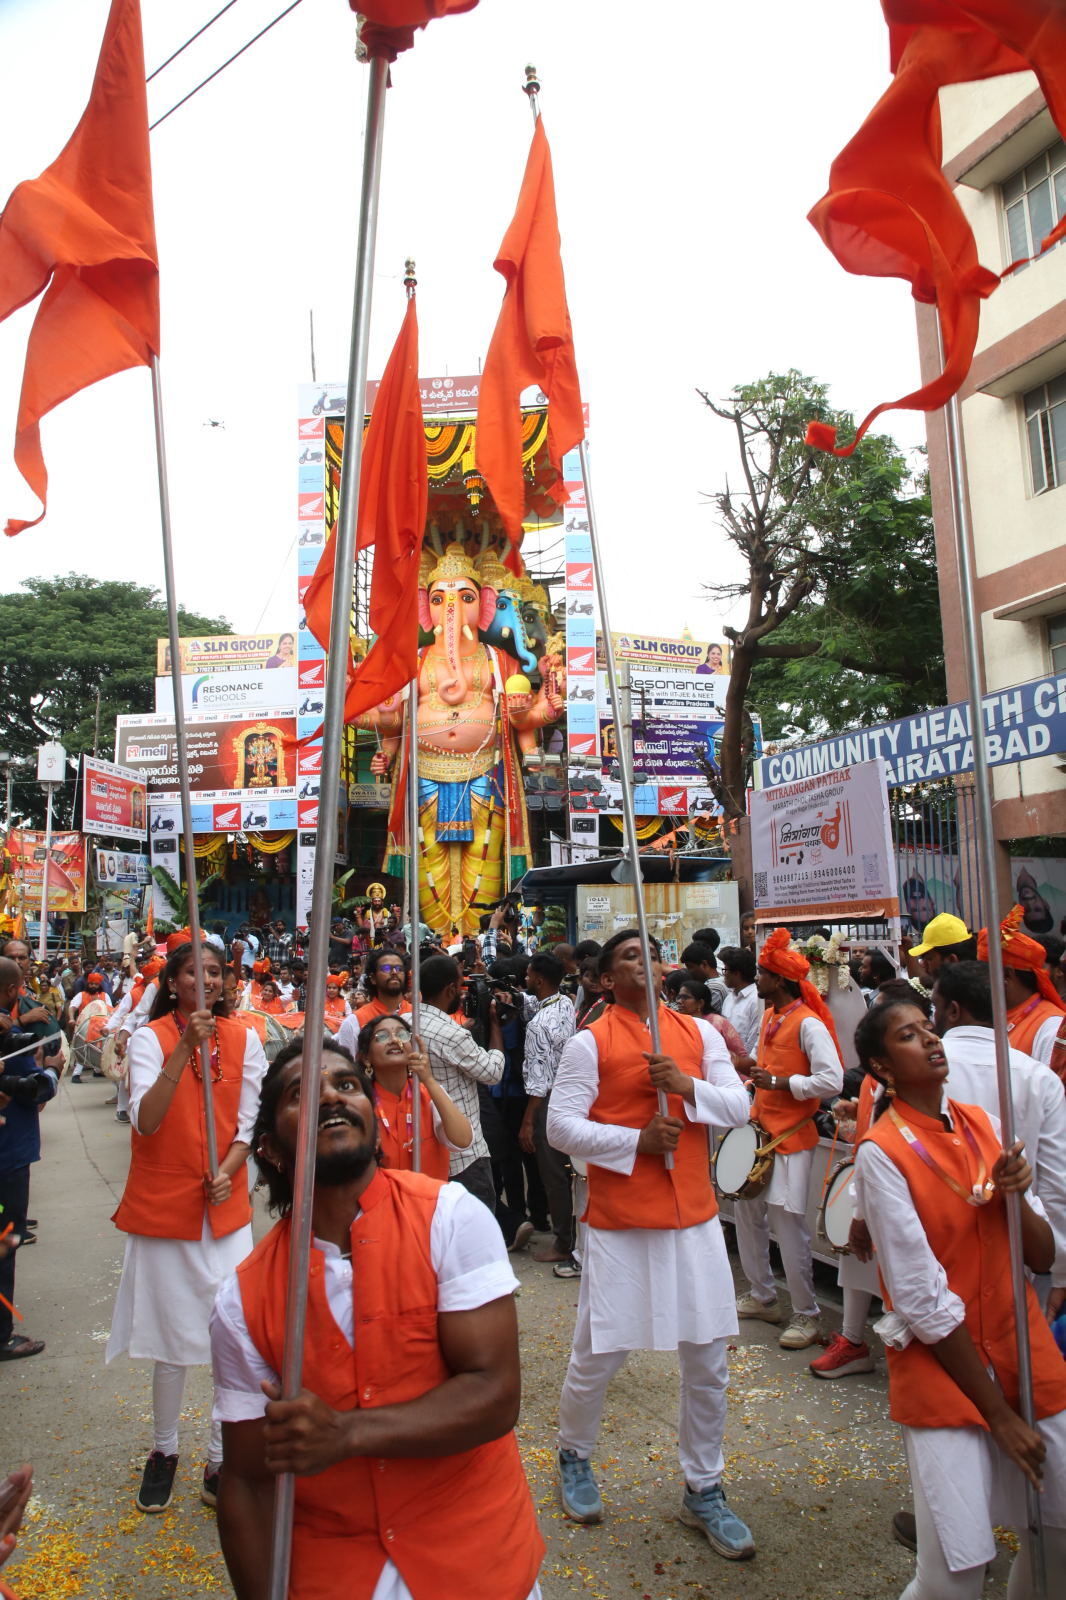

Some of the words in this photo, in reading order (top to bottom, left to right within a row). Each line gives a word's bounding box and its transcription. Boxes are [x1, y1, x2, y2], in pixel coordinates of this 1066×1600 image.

[204, 641, 228, 652] SLN
[231, 639, 274, 652] GROUP
[633, 640, 658, 652] SLN
[660, 644, 702, 656] GROUP
[203, 682, 264, 694] RESONANCE
[628, 676, 714, 691] Resonance
[203, 693, 246, 702] SCHOOLS
[768, 724, 901, 785] COMMUNITY
[910, 690, 1024, 750] HEATH
[142, 745, 166, 756] meil
[646, 741, 667, 750] meil
[766, 782, 820, 802] MITRAANGAN
[817, 767, 852, 788] PATHAK
[825, 786, 844, 798] GROUP
[780, 822, 822, 844] मित्रांगण
